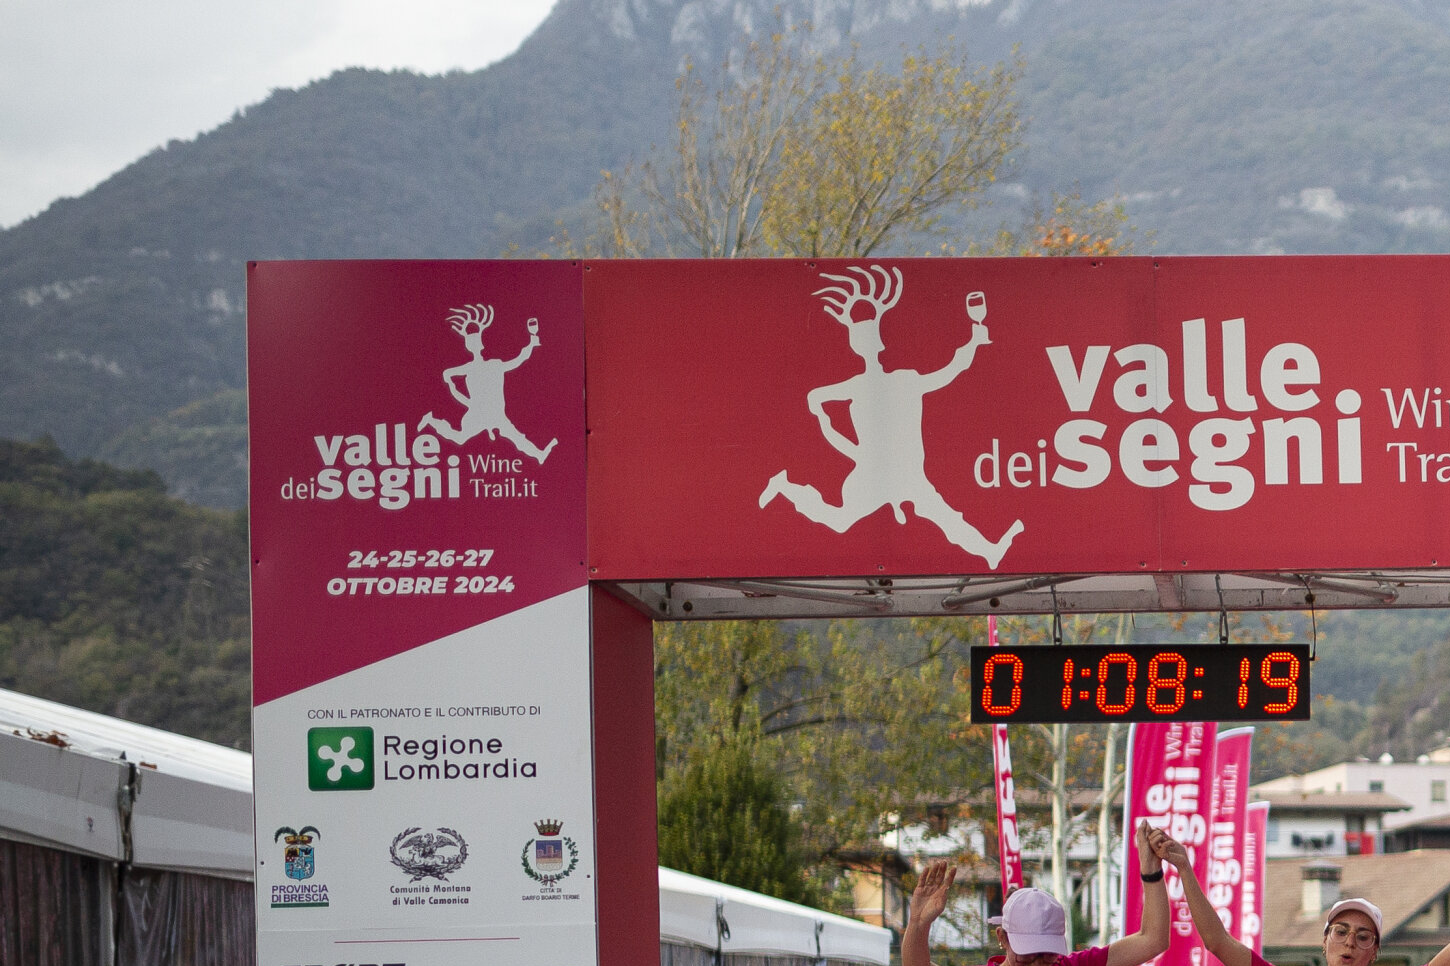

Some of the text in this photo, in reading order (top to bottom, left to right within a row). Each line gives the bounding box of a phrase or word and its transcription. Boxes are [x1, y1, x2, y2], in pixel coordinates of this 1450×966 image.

[1045, 317, 1321, 413] valle
[314, 423, 440, 466] valle
[468, 454, 523, 474] Wine
[469, 478, 538, 498] Trail.it
[347, 549, 494, 569] 24-25-26-27
[326, 575, 516, 596] OTTOBRE 2024
[307, 706, 541, 719] CON IL PATRONATO E IL CONTRIBUTO DI
[384, 734, 503, 760] Regione
[384, 758, 538, 780] Lombardia
[271, 884, 329, 894] PROVINCIA
[271, 893, 329, 903] DI BRESCIA
[433, 884, 471, 893] Montana
[392, 897, 470, 906] di Valle Camonica
